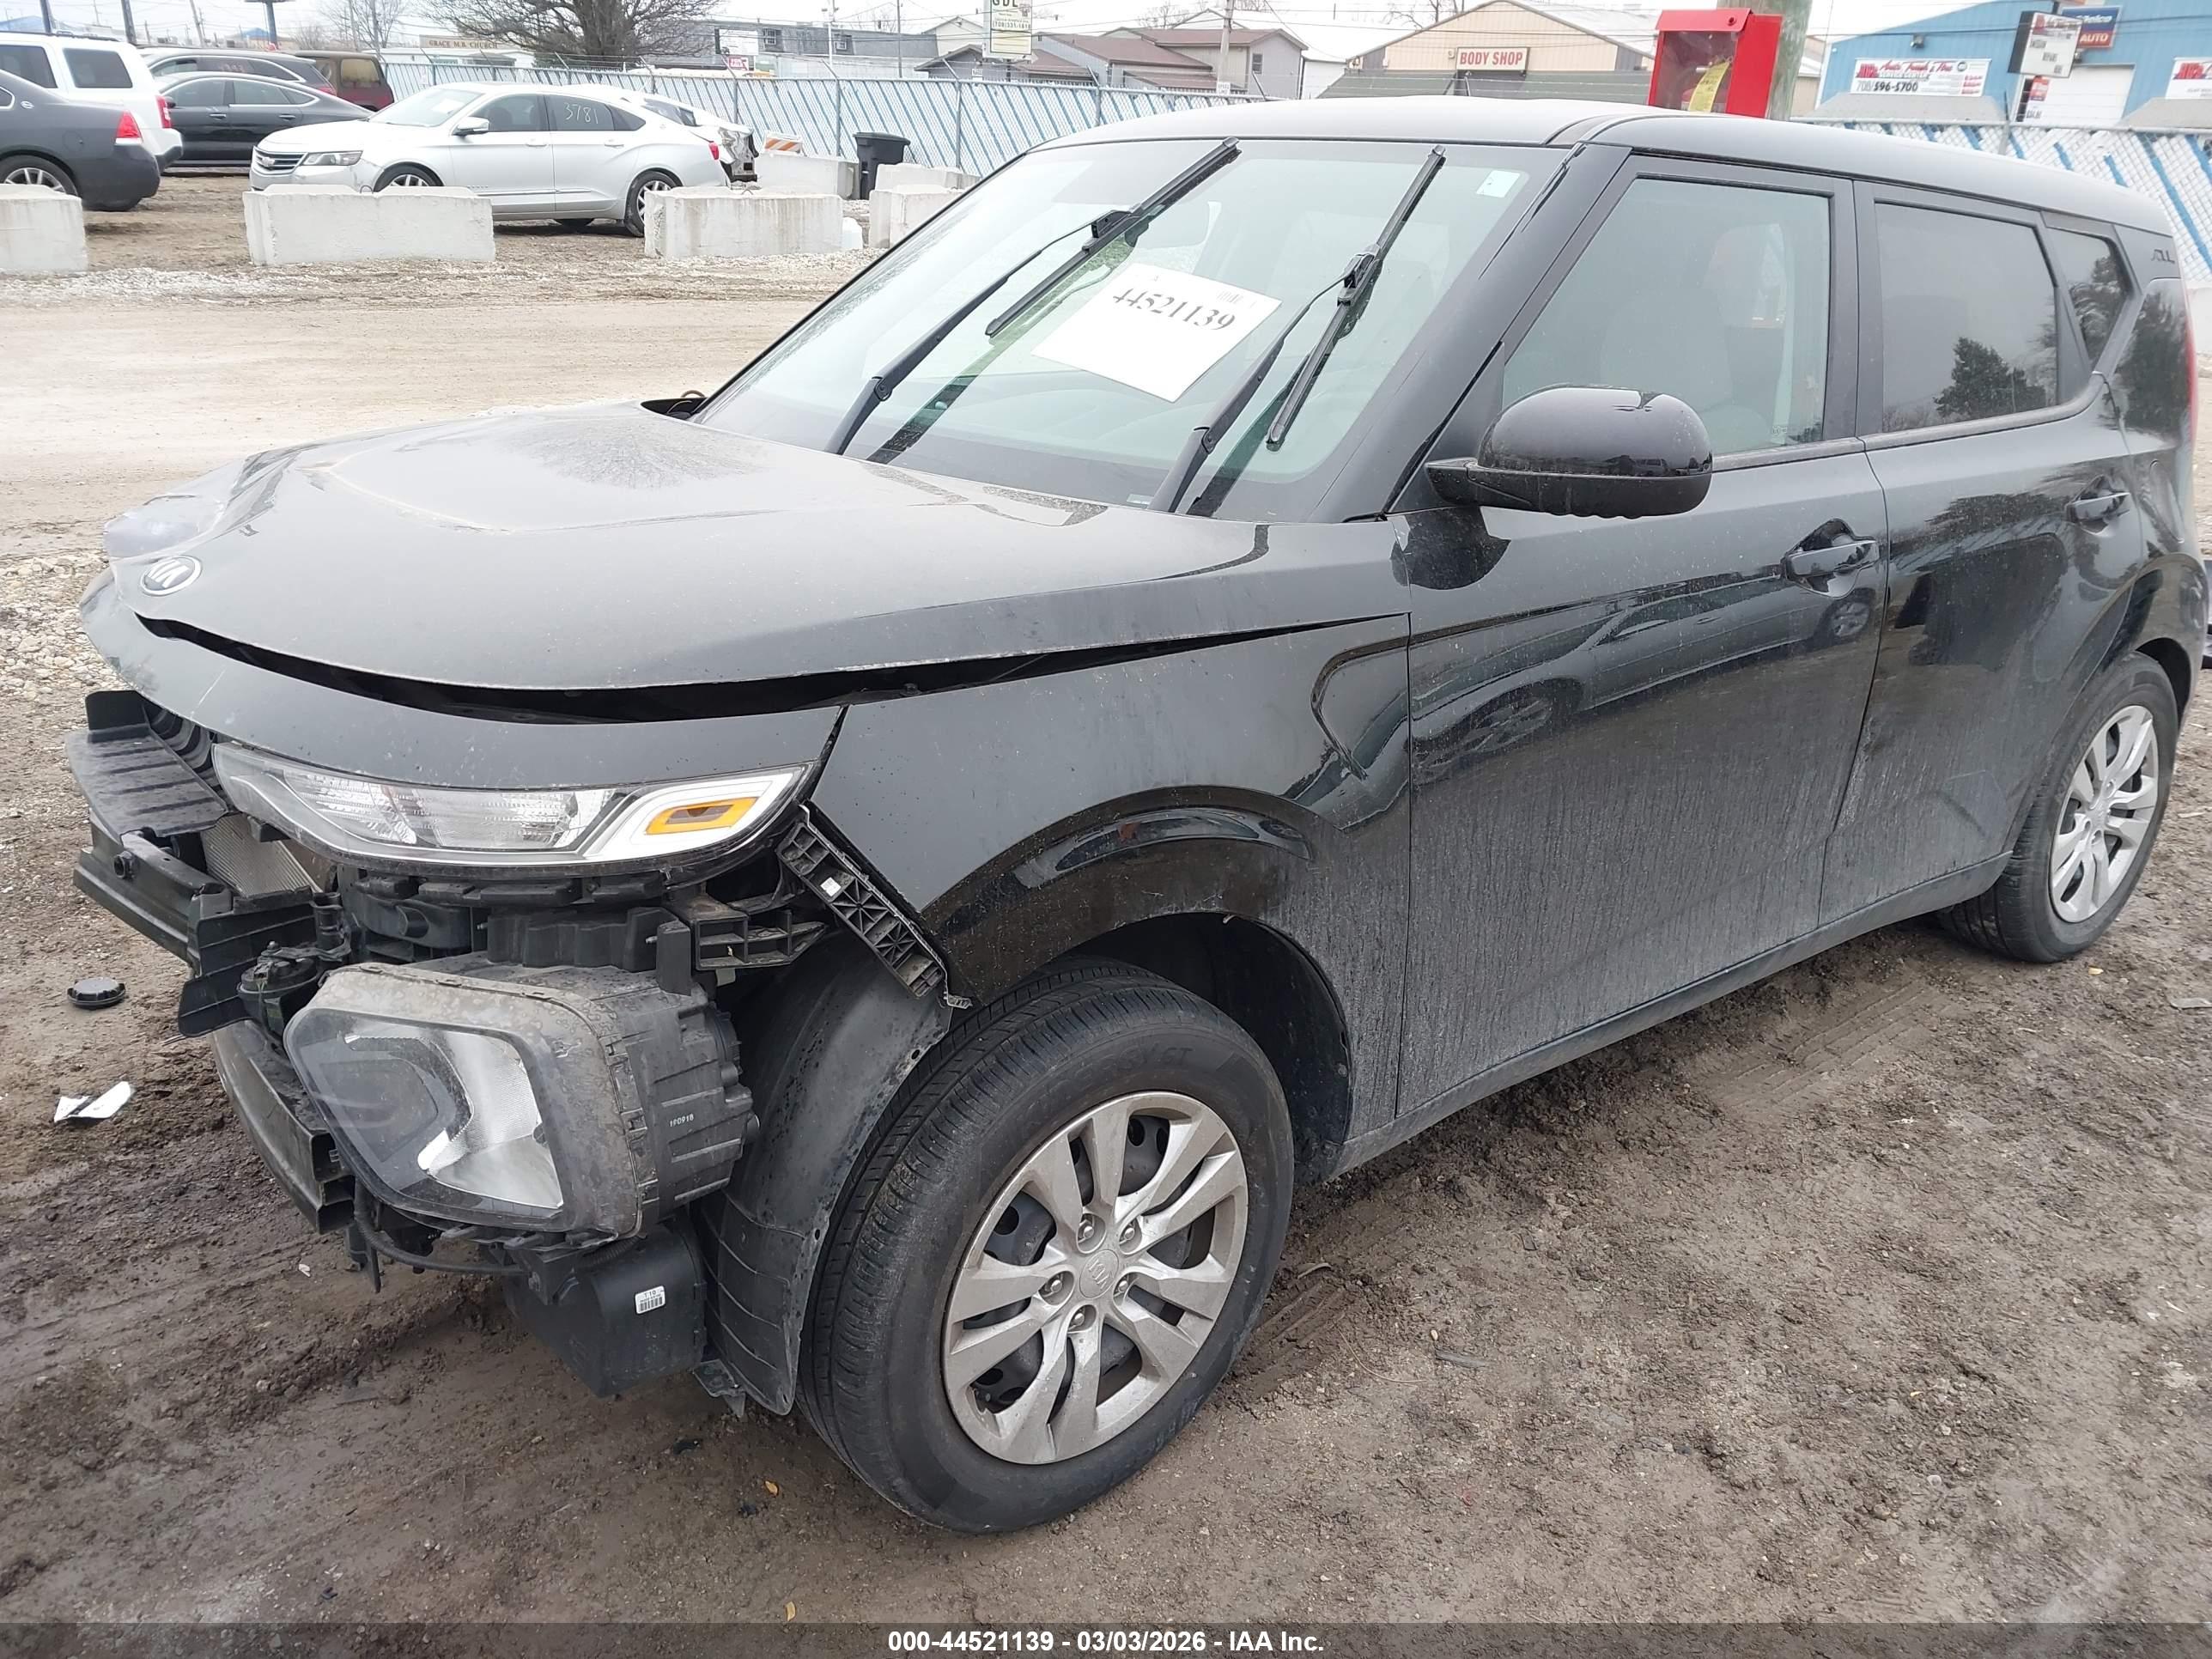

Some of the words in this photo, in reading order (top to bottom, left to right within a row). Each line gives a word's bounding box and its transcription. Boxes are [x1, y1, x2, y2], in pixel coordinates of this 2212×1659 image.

[2079, 33, 2109, 43] AUTO
[1460, 52, 1490, 65] BODY
[1492, 52, 1523, 65] SHOP
[563, 102, 599, 125] 3781
[1113, 288, 1237, 331] 44521139
